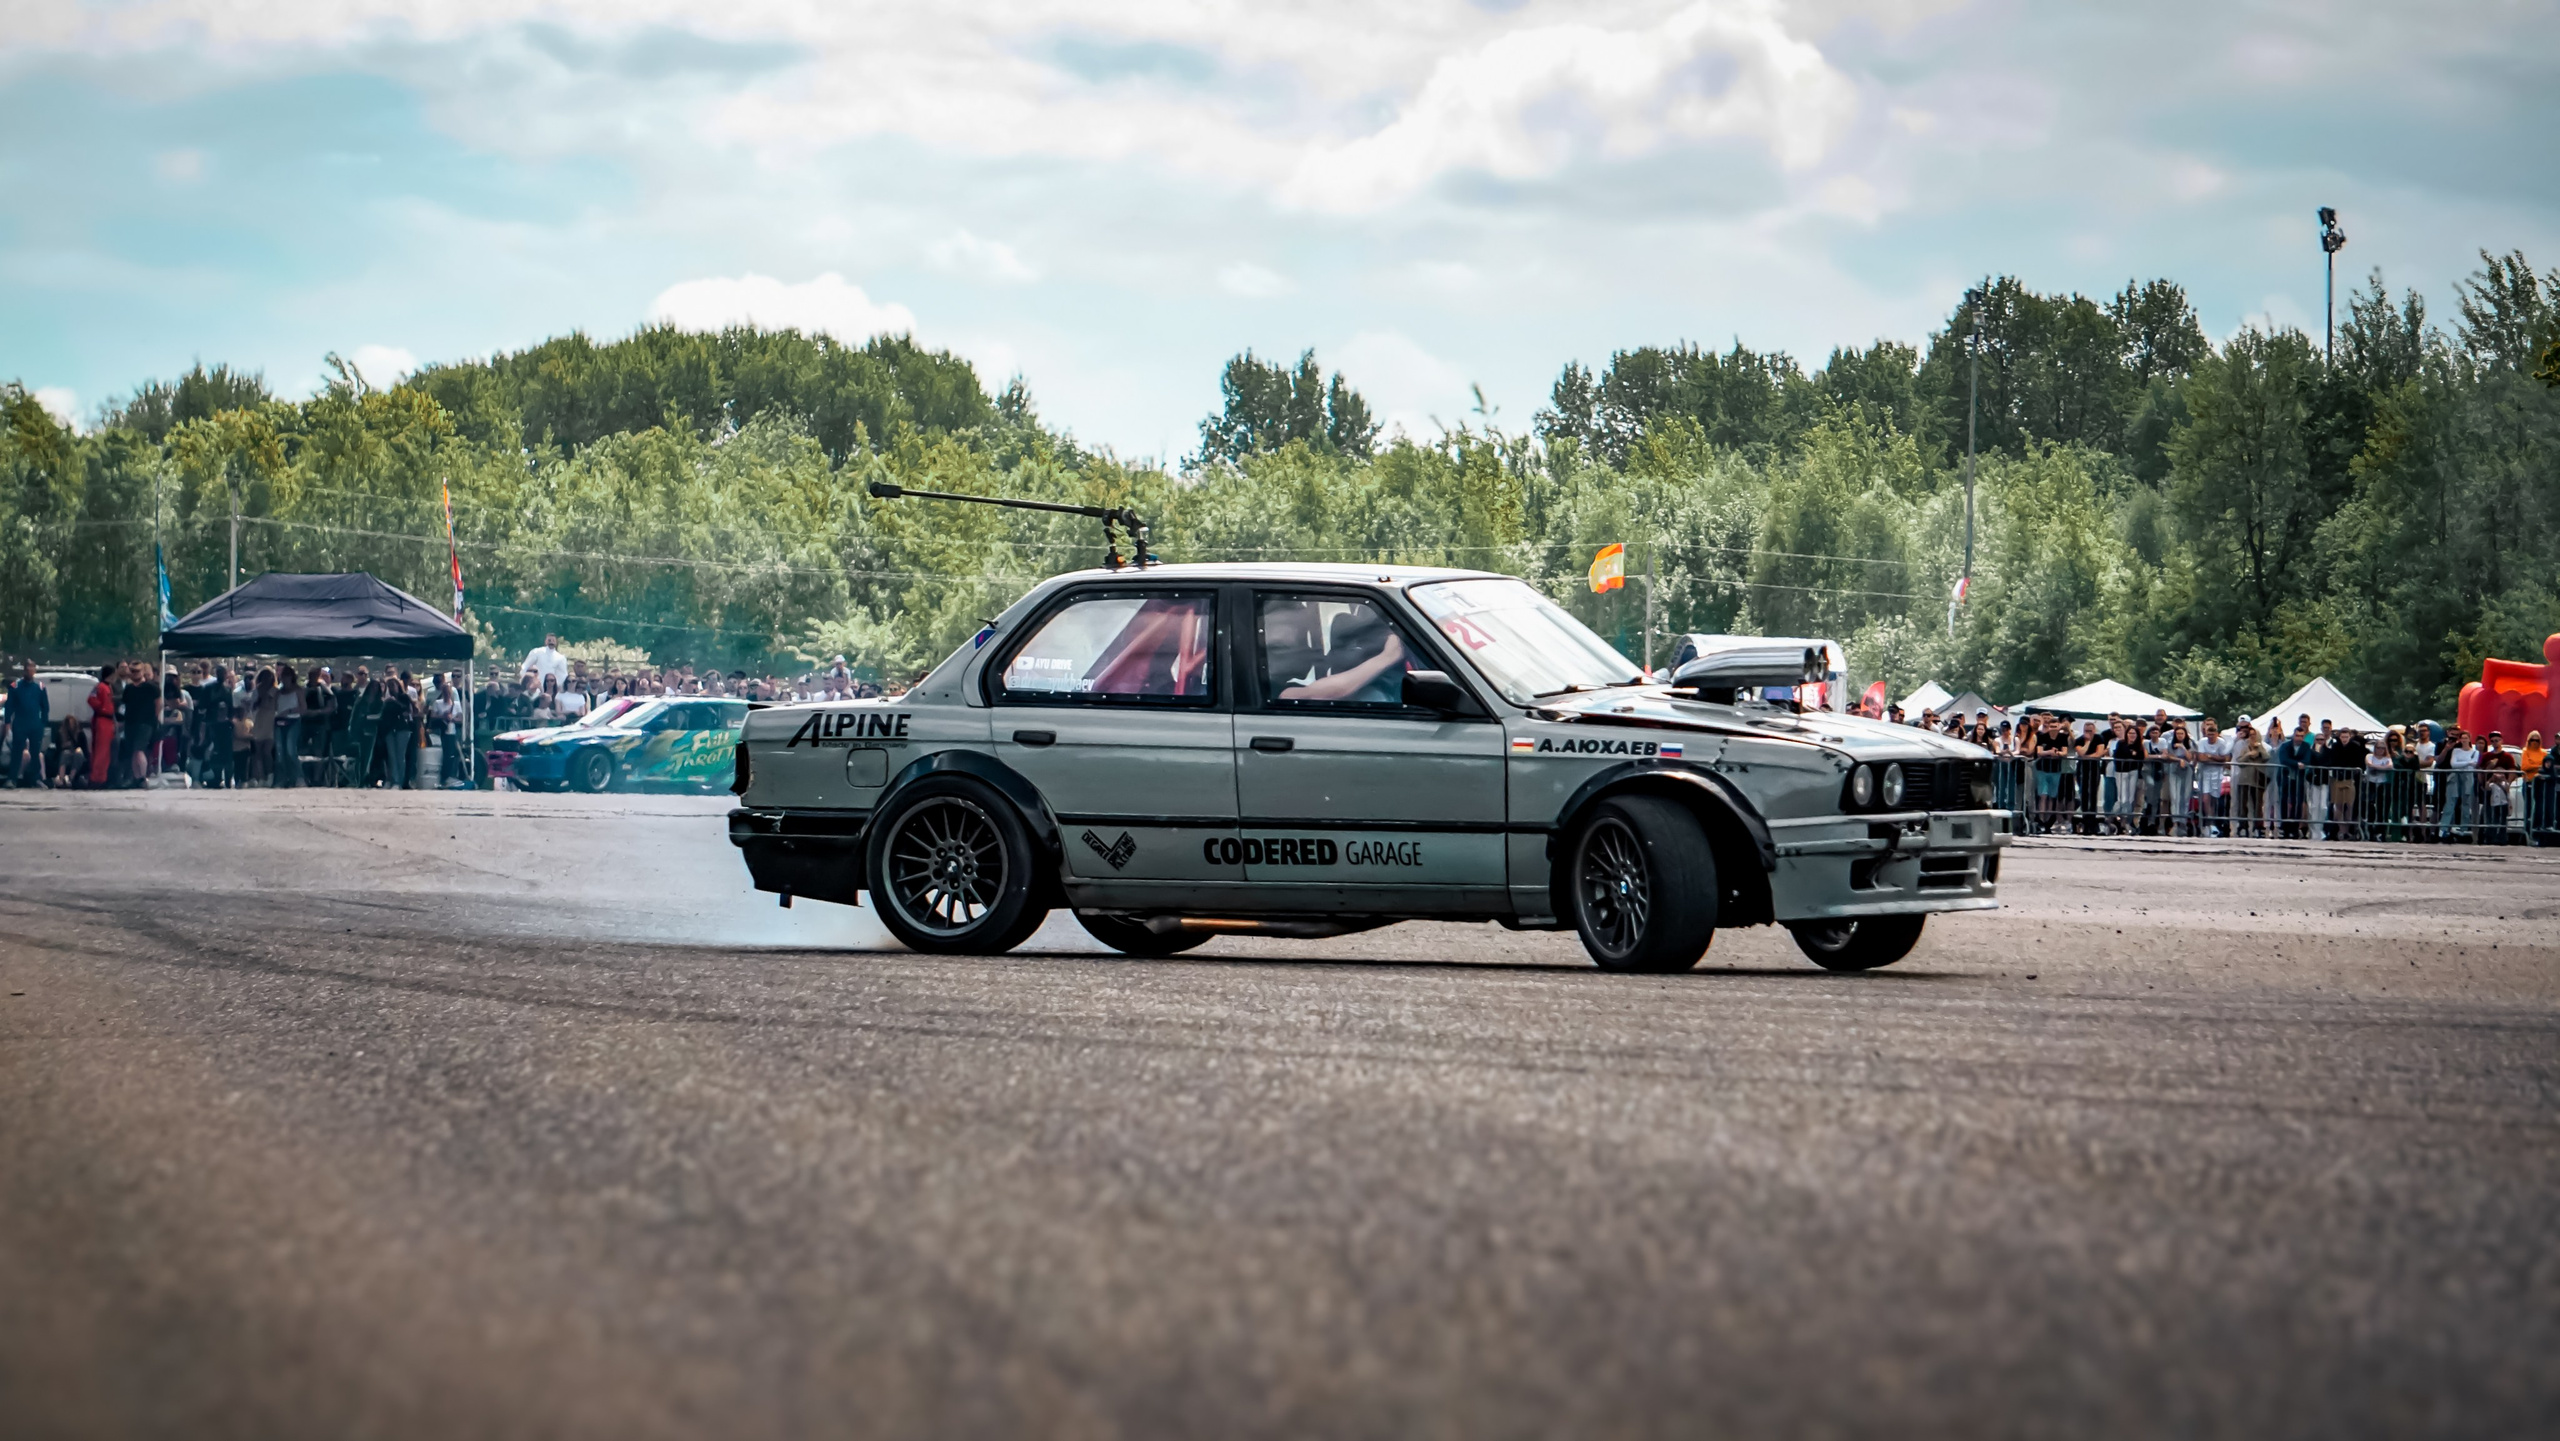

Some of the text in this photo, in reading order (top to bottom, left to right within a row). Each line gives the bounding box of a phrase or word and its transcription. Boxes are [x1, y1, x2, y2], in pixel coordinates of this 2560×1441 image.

[1446, 615, 1496, 651] 21
[1035, 658, 1050, 669] AYU
[787, 710, 911, 747] ALPINE
[1538, 738, 1658, 756] А.АЮХАЕВ
[1203, 837, 1423, 866] CODERED GARAGE
